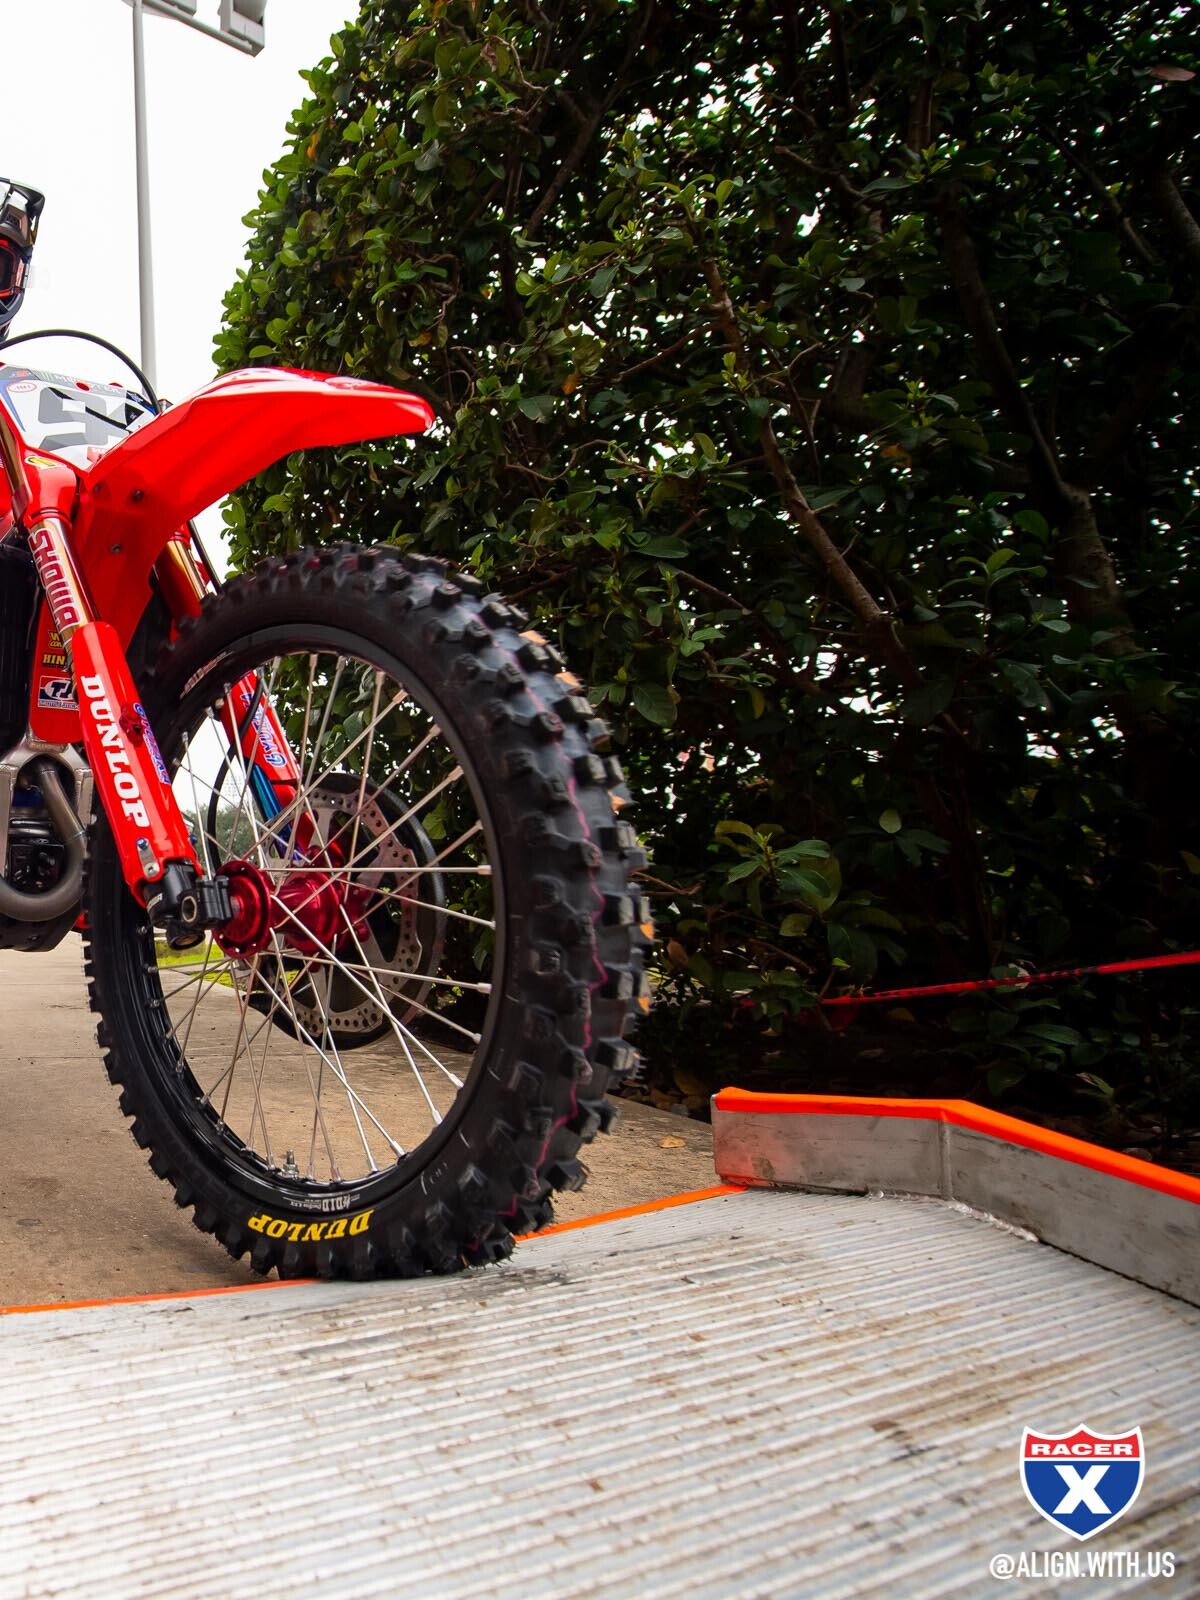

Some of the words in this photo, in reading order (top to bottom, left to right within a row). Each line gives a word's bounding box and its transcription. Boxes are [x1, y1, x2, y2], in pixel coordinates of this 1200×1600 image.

[27, 528, 81, 633] SHOWA
[42, 654, 66, 666] HIN
[80, 674, 150, 828] DUNLOP
[248, 1209, 375, 1242] DUNLOP
